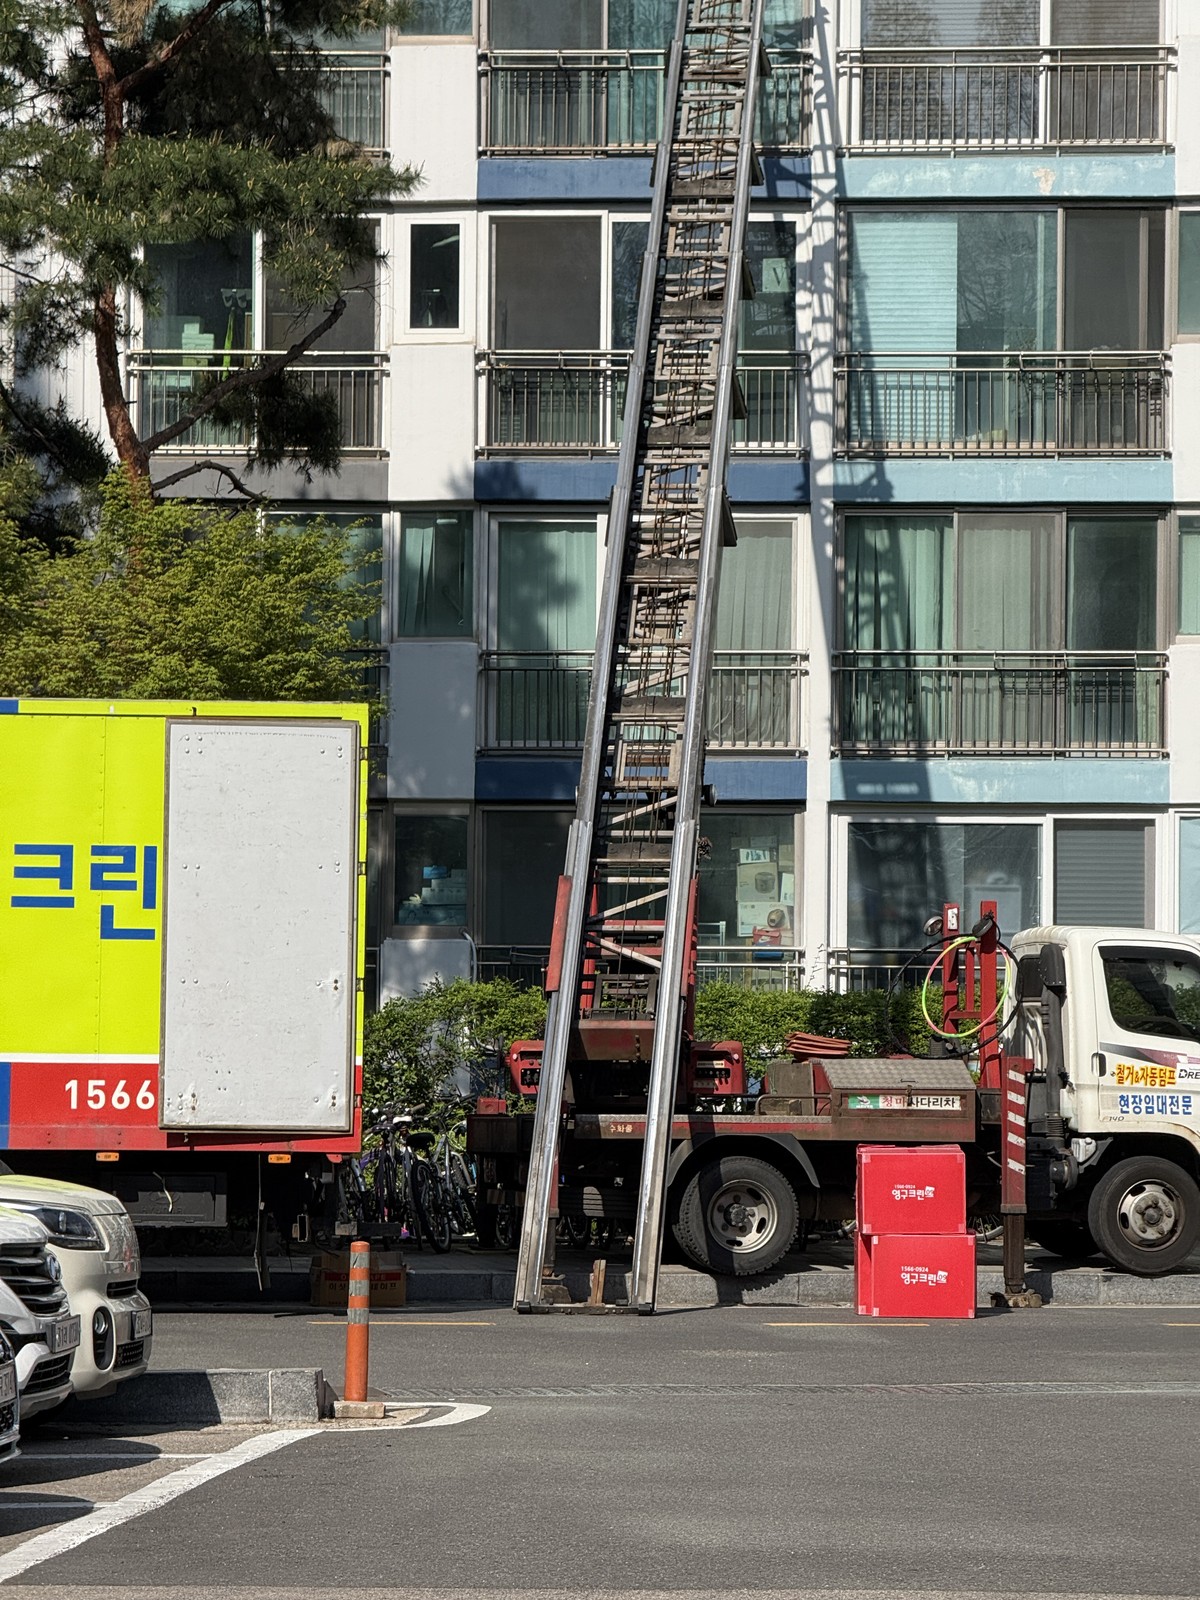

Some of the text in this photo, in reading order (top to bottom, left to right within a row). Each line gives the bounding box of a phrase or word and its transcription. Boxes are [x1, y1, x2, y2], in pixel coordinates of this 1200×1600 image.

[11, 844, 157, 940] 크린
[1116, 1064, 1176, 1087] 철거&자동덤프
[65, 1079, 155, 1110] 1566
[1119, 1094, 1193, 1115] 현장임대전문
[892, 1189, 925, 1200] 영구크린
[901, 1273, 936, 1286] 영구크린
